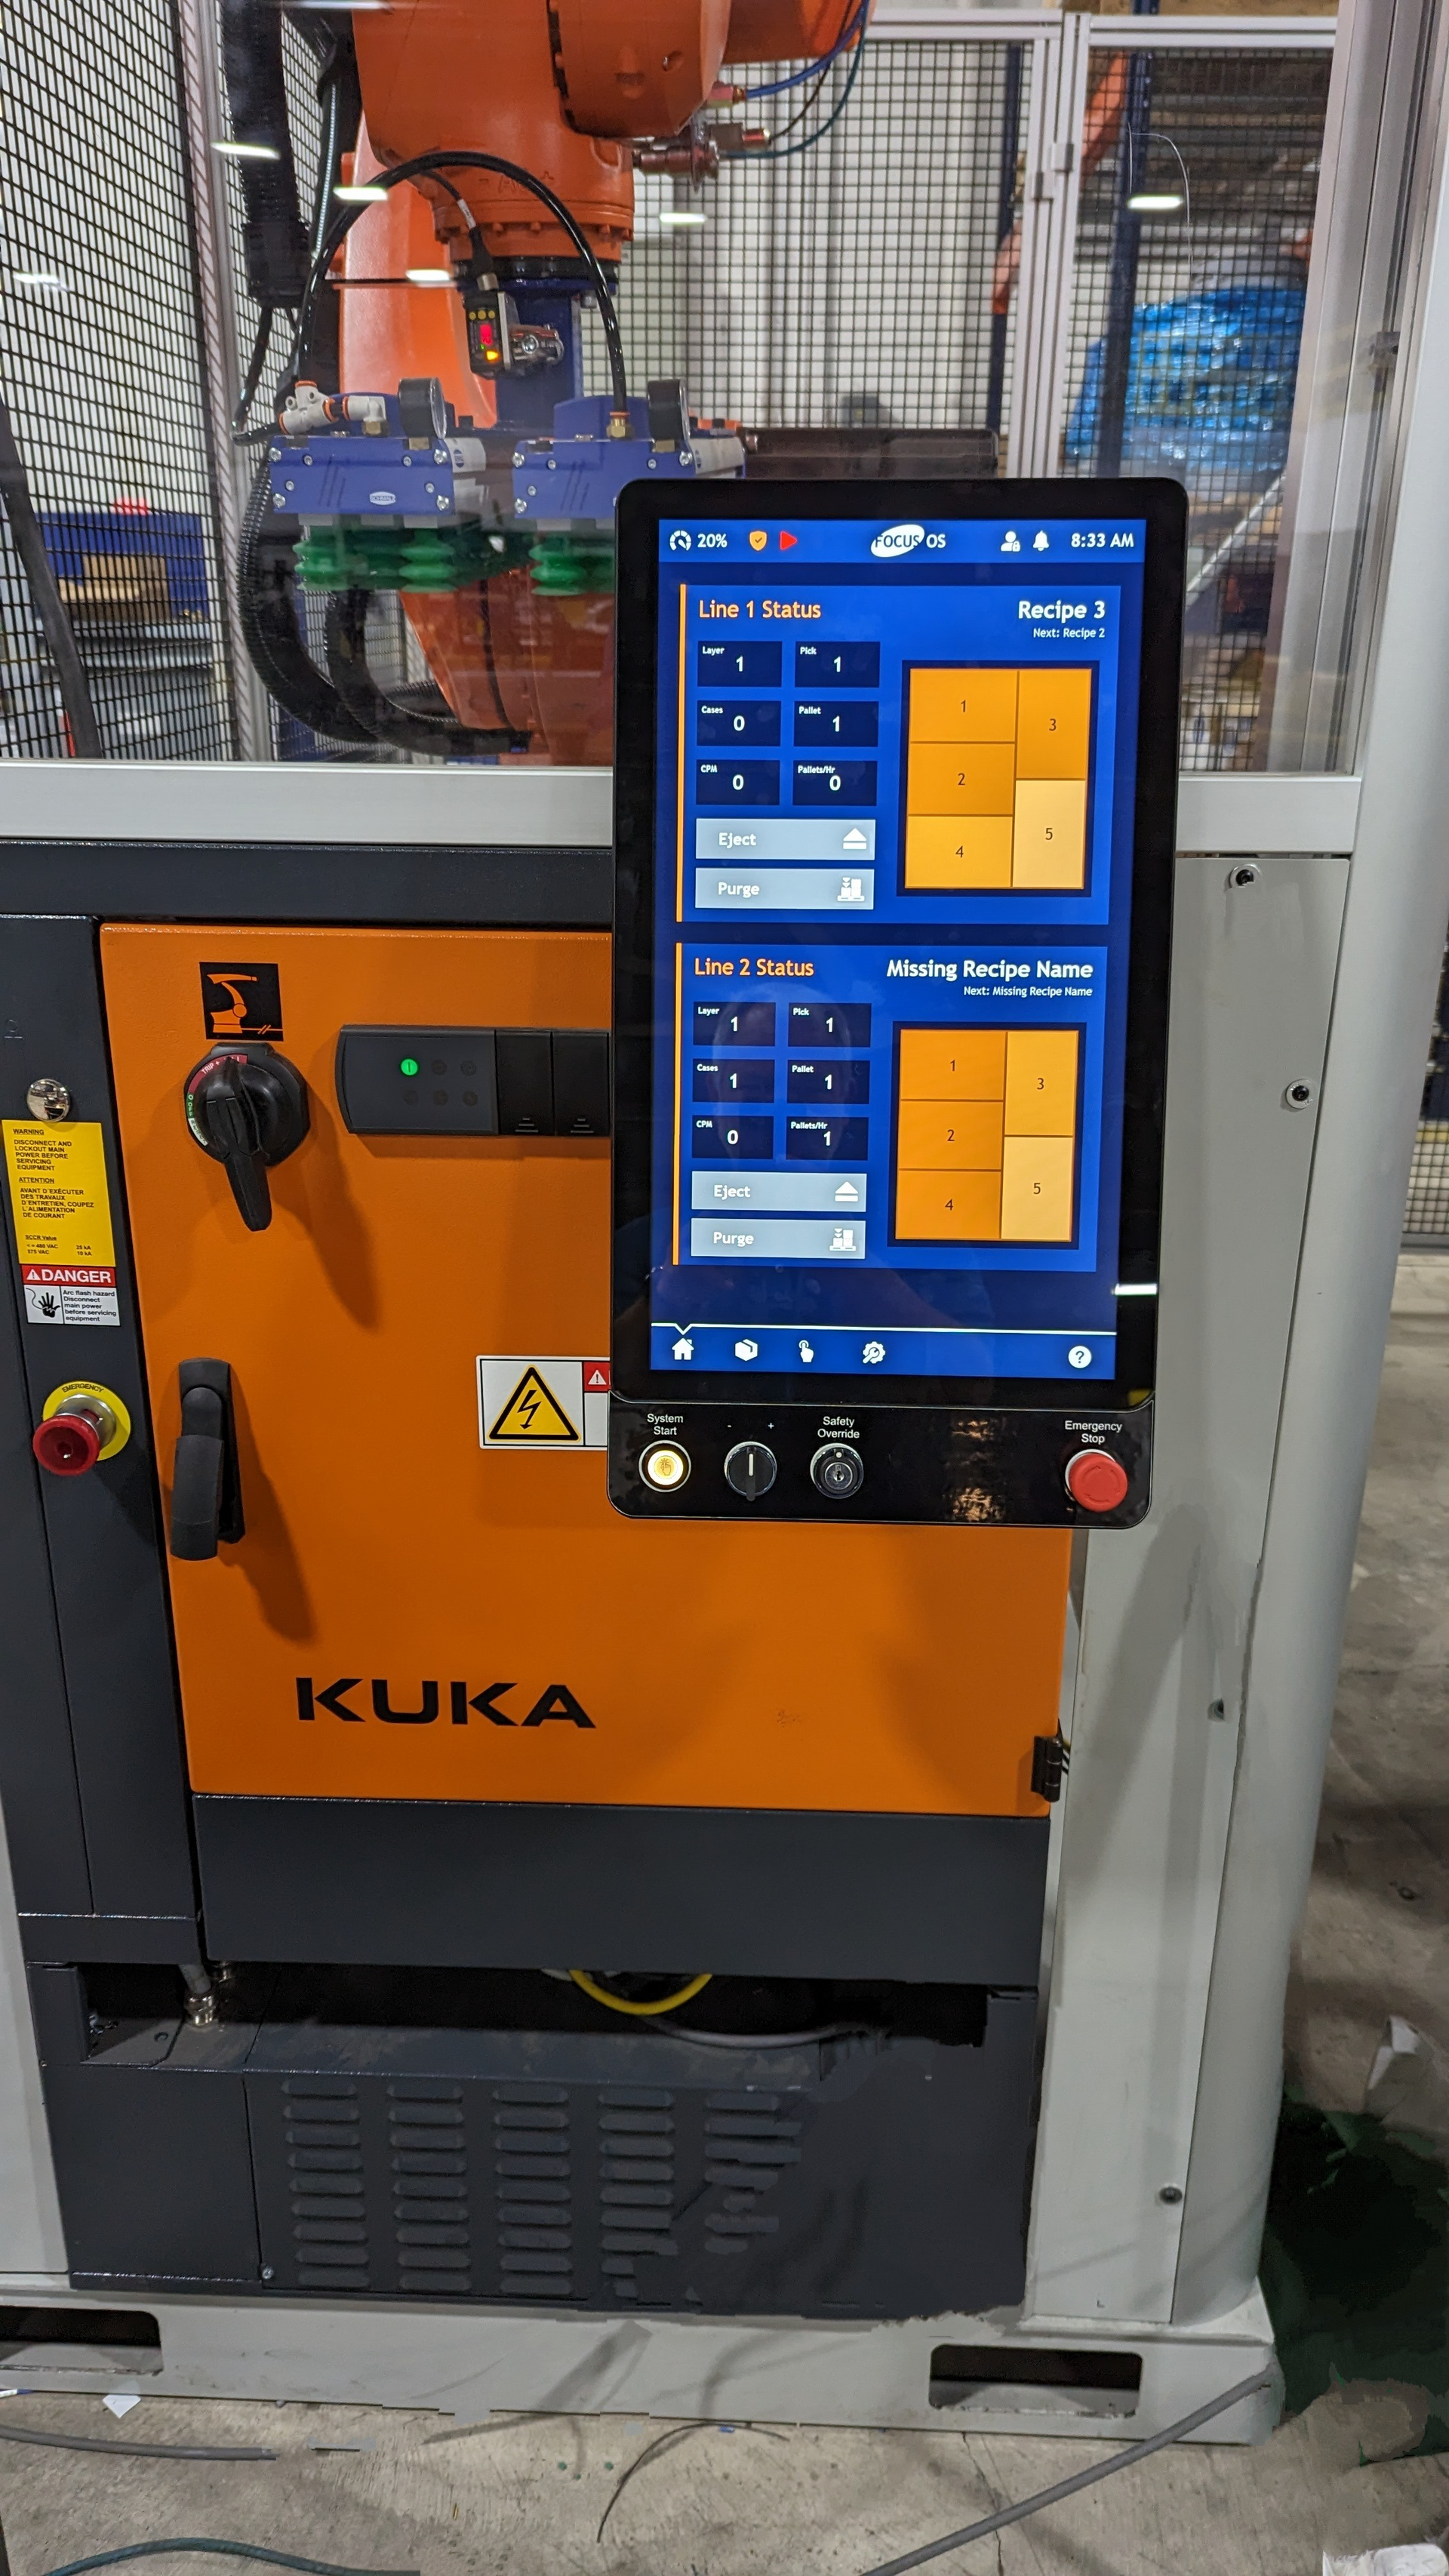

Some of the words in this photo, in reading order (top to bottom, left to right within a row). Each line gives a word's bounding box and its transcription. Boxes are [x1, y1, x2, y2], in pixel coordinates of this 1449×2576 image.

[697, 533, 728, 548] 20%
[875, 534, 920, 549] FOCUS
[926, 533, 946, 549] OS
[1071, 532, 1106, 548] 8:33
[1109, 533, 1134, 548] AM
[699, 599, 740, 618] Line
[746, 600, 755, 618] 1
[761, 599, 822, 619] Status
[1018, 599, 1088, 623] Recipe
[1094, 600, 1106, 619] 3
[1033, 627, 1060, 638] Next:
[1063, 627, 1097, 640] Recipe
[1098, 627, 1106, 638] 2
[702, 645, 725, 657] Layer
[799, 646, 817, 655] Pick
[736, 656, 743, 672] 1
[833, 656, 841, 672] 1
[701, 705, 724, 714] Cases
[798, 706, 822, 715] Pallet
[961, 700, 966, 713] 1
[733, 715, 746, 731] 0
[832, 716, 840, 732] 1
[1048, 718, 1057, 731] 3
[700, 764, 718, 773] CPM
[797, 765, 835, 774] Pallets/Hr
[732, 774, 744, 790] 0
[829, 775, 841, 791] 0
[958, 773, 966, 786] 2
[718, 832, 757, 849] Eject
[1045, 827, 1054, 841] 5
[955, 845, 964, 858] 4
[717, 882, 760, 898] Purge
[694, 957, 734, 976] Line
[739, 958, 751, 976] 2
[756, 958, 814, 977] Status
[886, 959, 958, 982] Missing
[963, 959, 1031, 982] Recipe
[1036, 960, 1094, 978] Name
[964, 986, 990, 996] Next:
[992, 986, 1028, 999] Missing
[1029, 986, 1063, 999] Recipe
[1064, 986, 1093, 996] Name
[697, 1006, 720, 1017] Layer
[792, 1007, 810, 1016] Pick
[731, 1016, 738, 1032] 1
[826, 1017, 833, 1033] 1
[202, 1063, 214, 1074] TRIP
[697, 1063, 718, 1072] Cases
[792, 1064, 814, 1073] Pallet
[949, 1059, 955, 1072] 1
[730, 1073, 737, 1089] 1
[824, 1074, 832, 1090] 1
[1036, 1077, 1044, 1090] 3
[696, 1119, 713, 1128] CPM
[790, 1121, 828, 1130] Pallets/Hr
[727, 1129, 739, 1145] 0
[823, 1131, 831, 1146] 1
[947, 1129, 955, 1143] 2
[712, 1184, 751, 1202] Eject
[1033, 1182, 1041, 1195] 5
[943, 1198, 955, 1211] 4
[713, 1231, 755, 1248] Purge
[42, 1269, 112, 1283] DANGER
[62, 1383, 104, 1393] EMERGENCY
[647, 1414, 684, 1426] System
[823, 1417, 855, 1430] Safety
[653, 1425, 677, 1436] Start
[1065, 1420, 1122, 1434] Emergency
[817, 1429, 860, 1439] Override
[1081, 1433, 1106, 1445] Stop
[296, 1677, 596, 1728] KUKA
